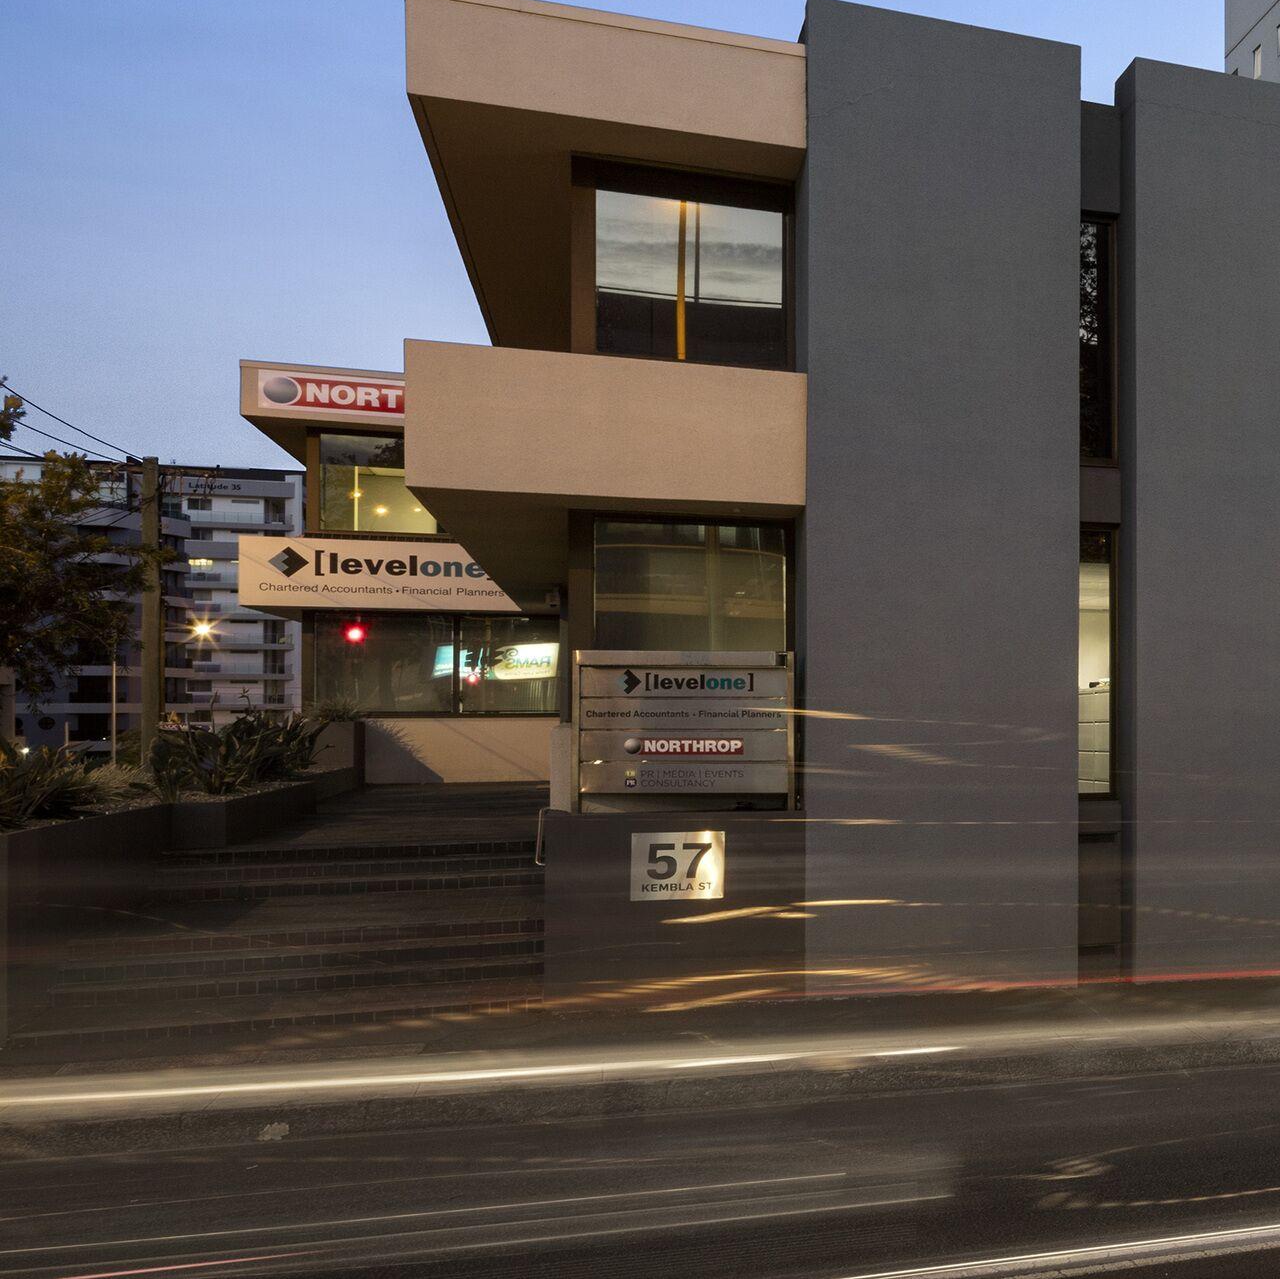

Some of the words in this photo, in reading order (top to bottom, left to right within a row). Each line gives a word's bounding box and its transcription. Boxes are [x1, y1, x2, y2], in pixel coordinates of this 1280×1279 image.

[259, 582, 319, 593] Chartered
[321, 584, 393, 595] Accountants
[401, 586, 452, 596] Financial
[456, 587, 505, 598] Planners
[586, 709, 632, 719] Chartered
[633, 709, 690, 719] Accountants
[698, 709, 740, 719] Financial
[741, 709, 782, 719] Planners
[644, 739, 742, 753] NORTHROP
[641, 770, 655, 778] PR
[662, 770, 696, 778] MEDIA
[705, 770, 744, 778] EVENTS
[640, 779, 717, 788] CONSULTANCY
[646, 842, 712, 880] 57
[641, 882, 694, 893] KEMBLA
[698, 881, 712, 891] ST
